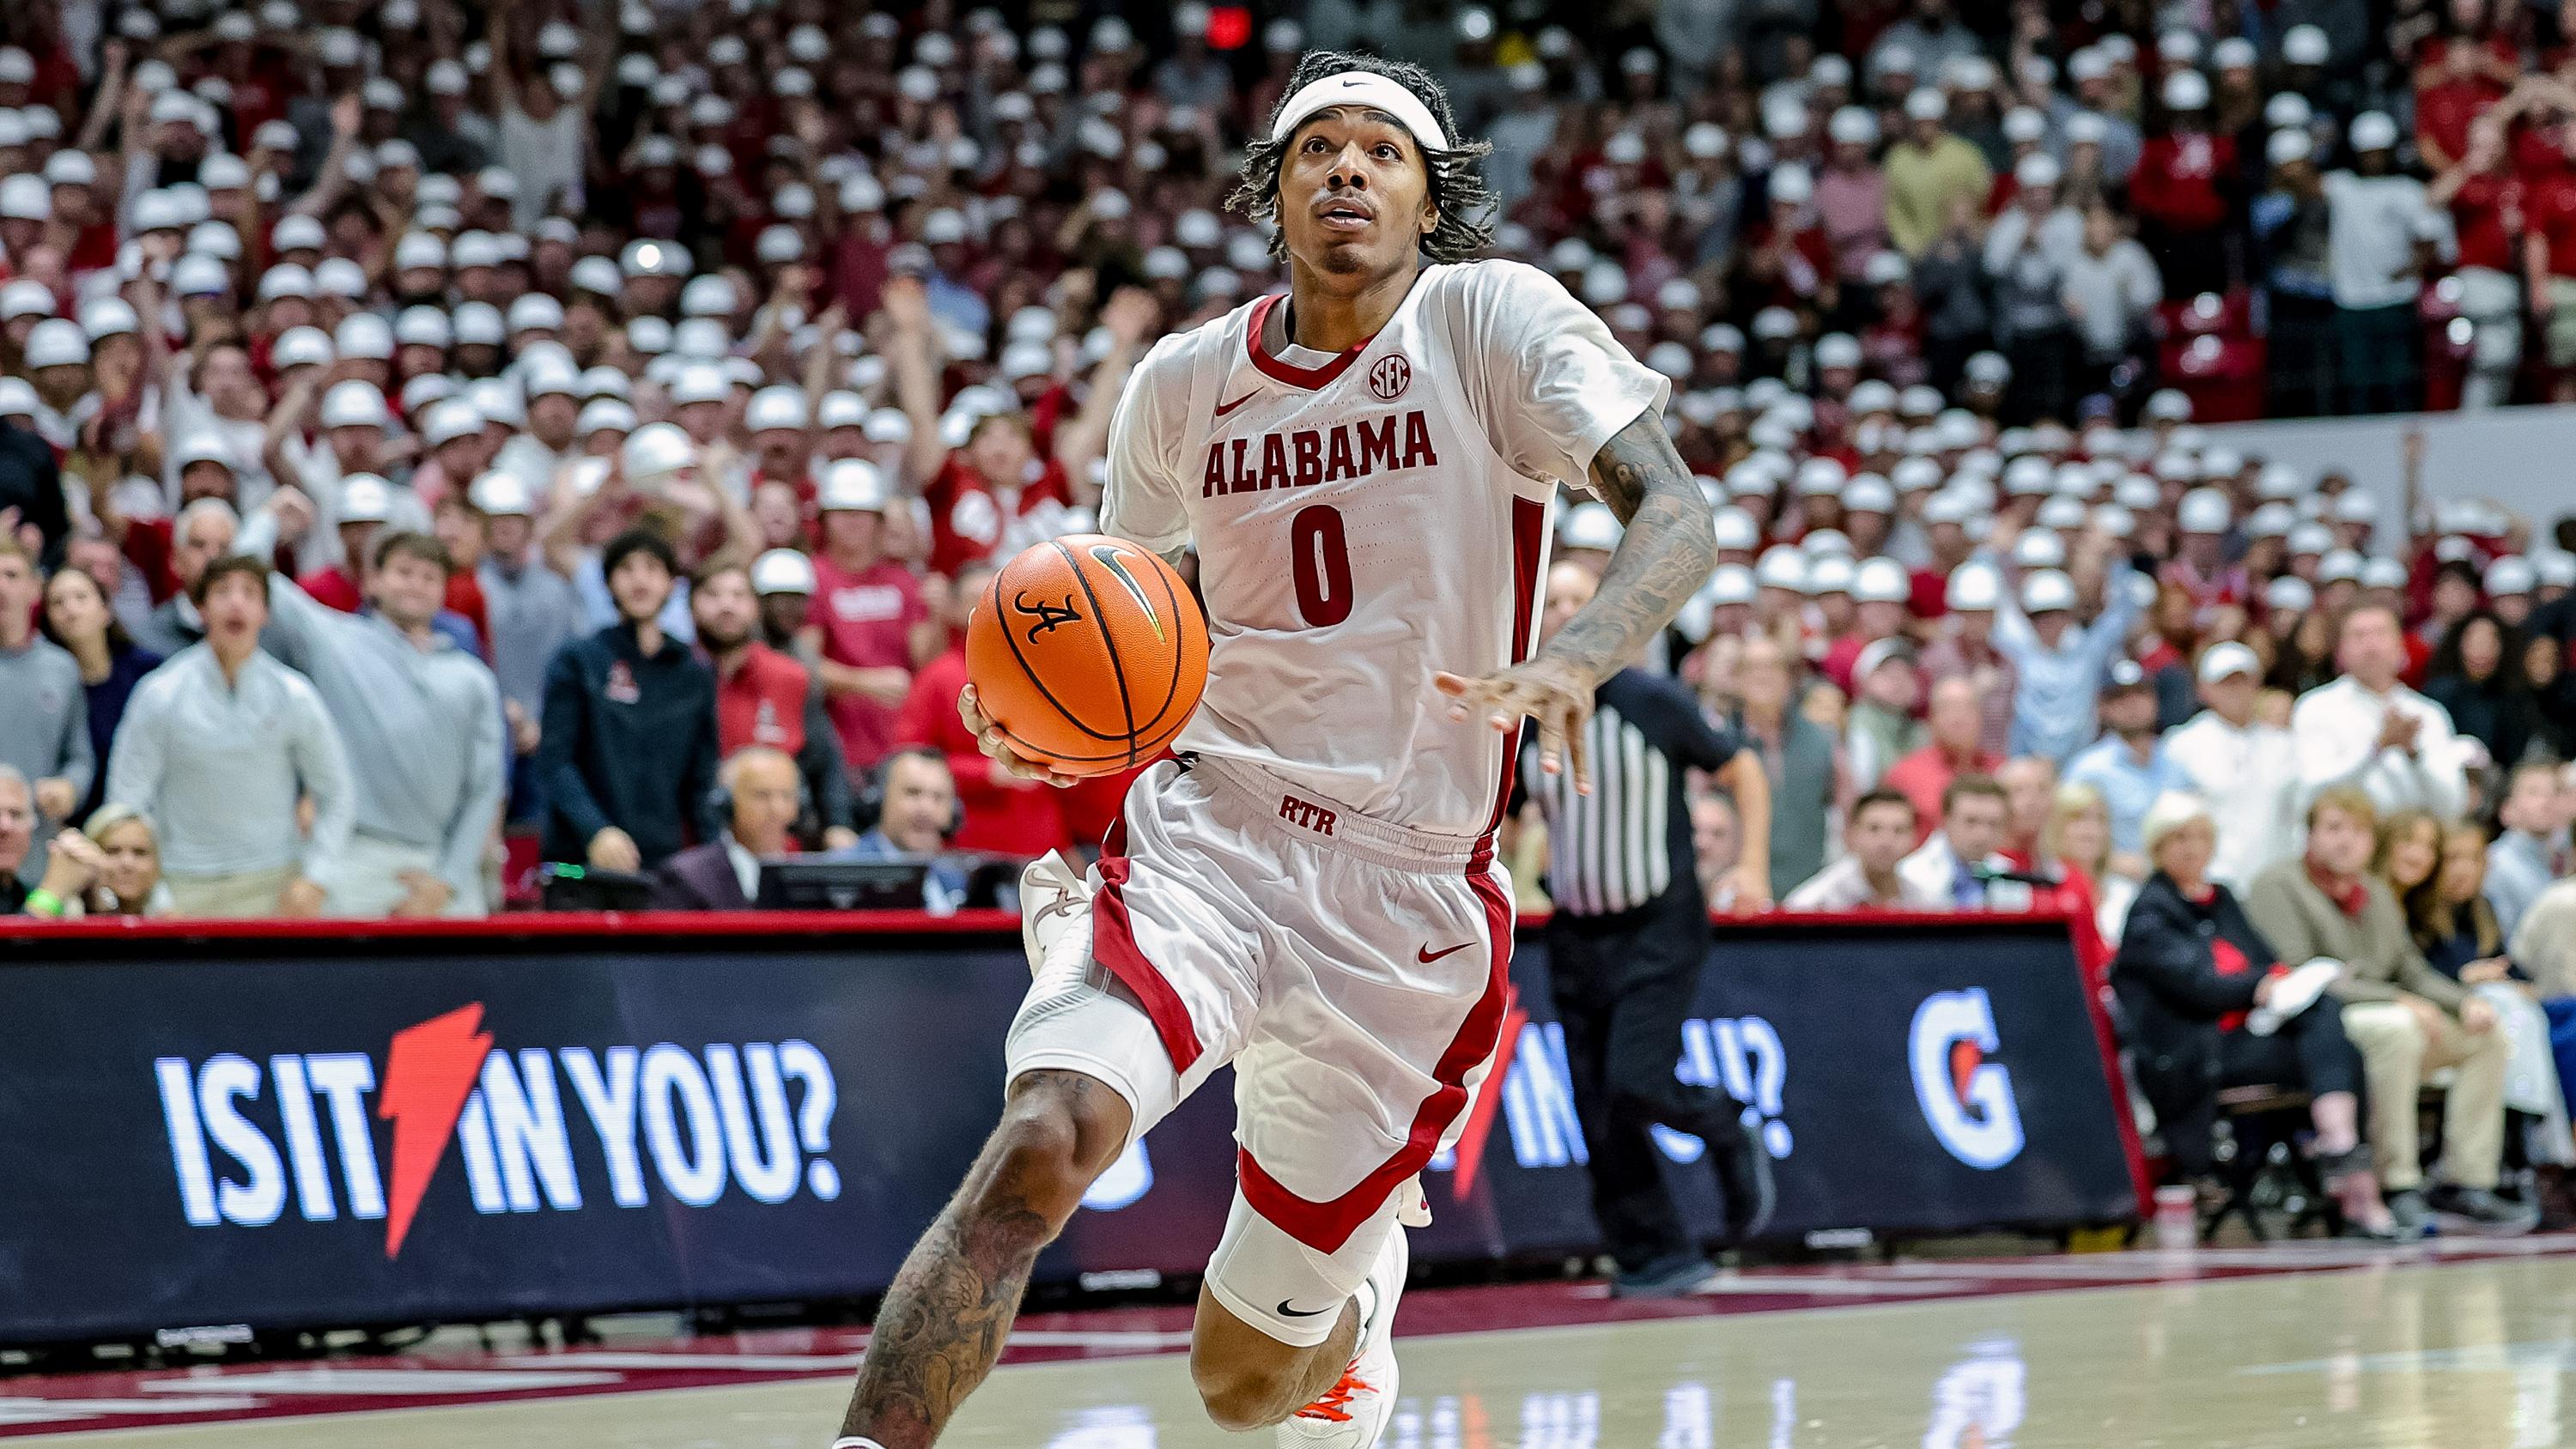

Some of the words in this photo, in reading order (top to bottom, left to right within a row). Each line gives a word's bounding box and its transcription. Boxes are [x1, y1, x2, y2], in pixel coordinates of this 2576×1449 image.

[1371, 357, 1408, 397] SEC
[1202, 410, 1438, 498] ALABAMA
[1291, 504, 1354, 627] 0
[1279, 794, 1337, 837] RTR
[1907, 986, 2026, 1171] G
[154, 1052, 288, 1227] IS
[269, 1052, 387, 1222] IT
[457, 1048, 583, 1214] IN
[558, 1039, 841, 1208] YOU?
